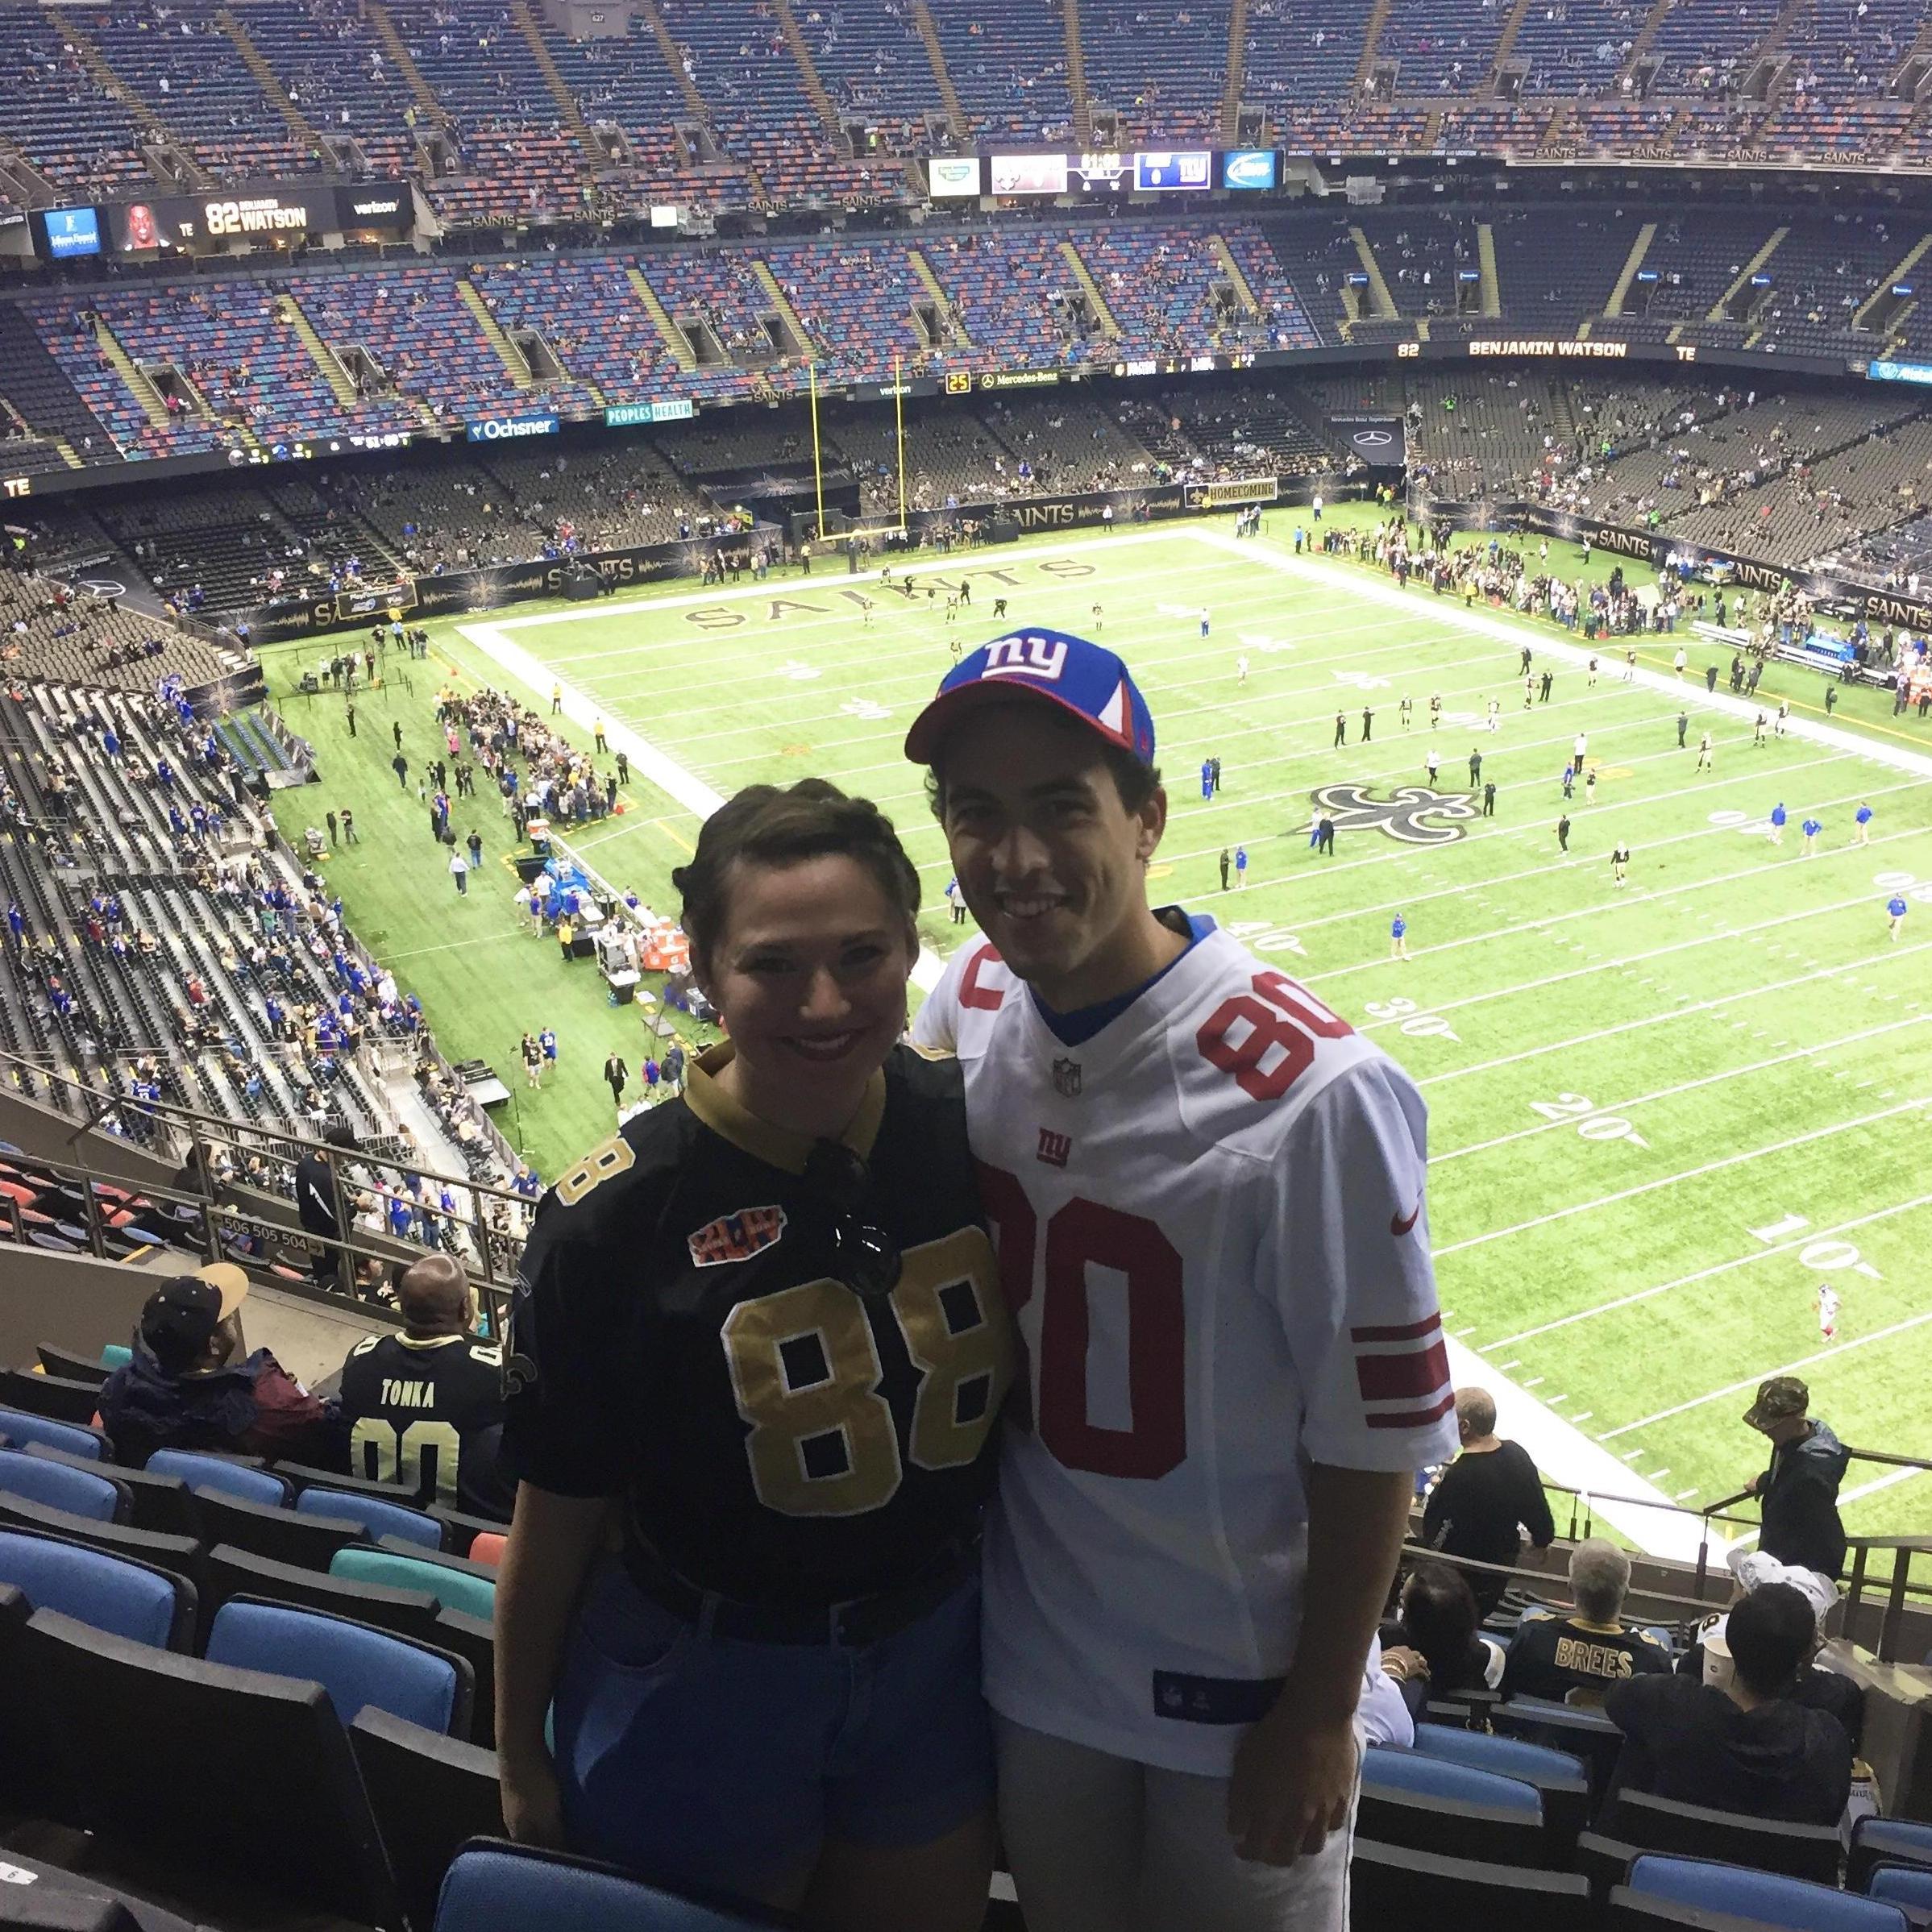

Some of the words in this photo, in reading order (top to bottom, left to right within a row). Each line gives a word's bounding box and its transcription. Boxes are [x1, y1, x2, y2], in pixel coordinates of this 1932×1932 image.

[1535, 147, 1576, 159] SAINTS
[1632, 148, 1672, 160] SAINTS
[1727, 151, 1767, 162] SAINTS
[1822, 152, 1865, 164] SAINTS
[354, 201, 397, 214] verizon
[748, 201, 787, 212] SAINTS
[842, 196, 881, 206] SAINTS
[205, 202, 242, 235] 82
[242, 207, 307, 231] WATSON
[472, 215, 516, 227] SAINTS
[574, 210, 616, 222] SAINTS
[179, 223, 193, 237] TE
[1398, 343, 1420, 357] 82
[1469, 342, 1555, 356] BENJAMIN
[1557, 343, 1627, 357] WATSON
[1676, 346, 1696, 361] TE
[949, 376, 968, 391] 25
[996, 372, 1057, 385] Mercedes-Benz
[754, 388, 794, 403] SAINTS
[608, 405, 651, 424] PEOPLES
[654, 402, 692, 418] HEALTH
[484, 419, 552, 439] Ochsner
[4, 478, 31, 497] TE
[1210, 483, 1274, 500] HOMECOMING
[1598, 530, 1650, 556] SAINTS
[1735, 562, 1781, 588] AINTS
[685, 560, 1096, 629] SAINTS
[1867, 596, 1932, 629] SAINTS
[982, 636, 1068, 681] ny
[1363, 996, 1450, 1037] 30
[1196, 970, 1357, 1102] 80
[1529, 1092, 1633, 1141] 20
[224, 1217, 250, 1235] 506
[252, 1224, 278, 1242] 505
[282, 1233, 308, 1251] 504
[1747, 1213, 1861, 1270] 10
[721, 1224, 1014, 1518] 88
[380, 1377, 435, 1408] TONKA
[350, 1416, 460, 1511] 00
[1554, 1636, 1634, 1679] BREES
